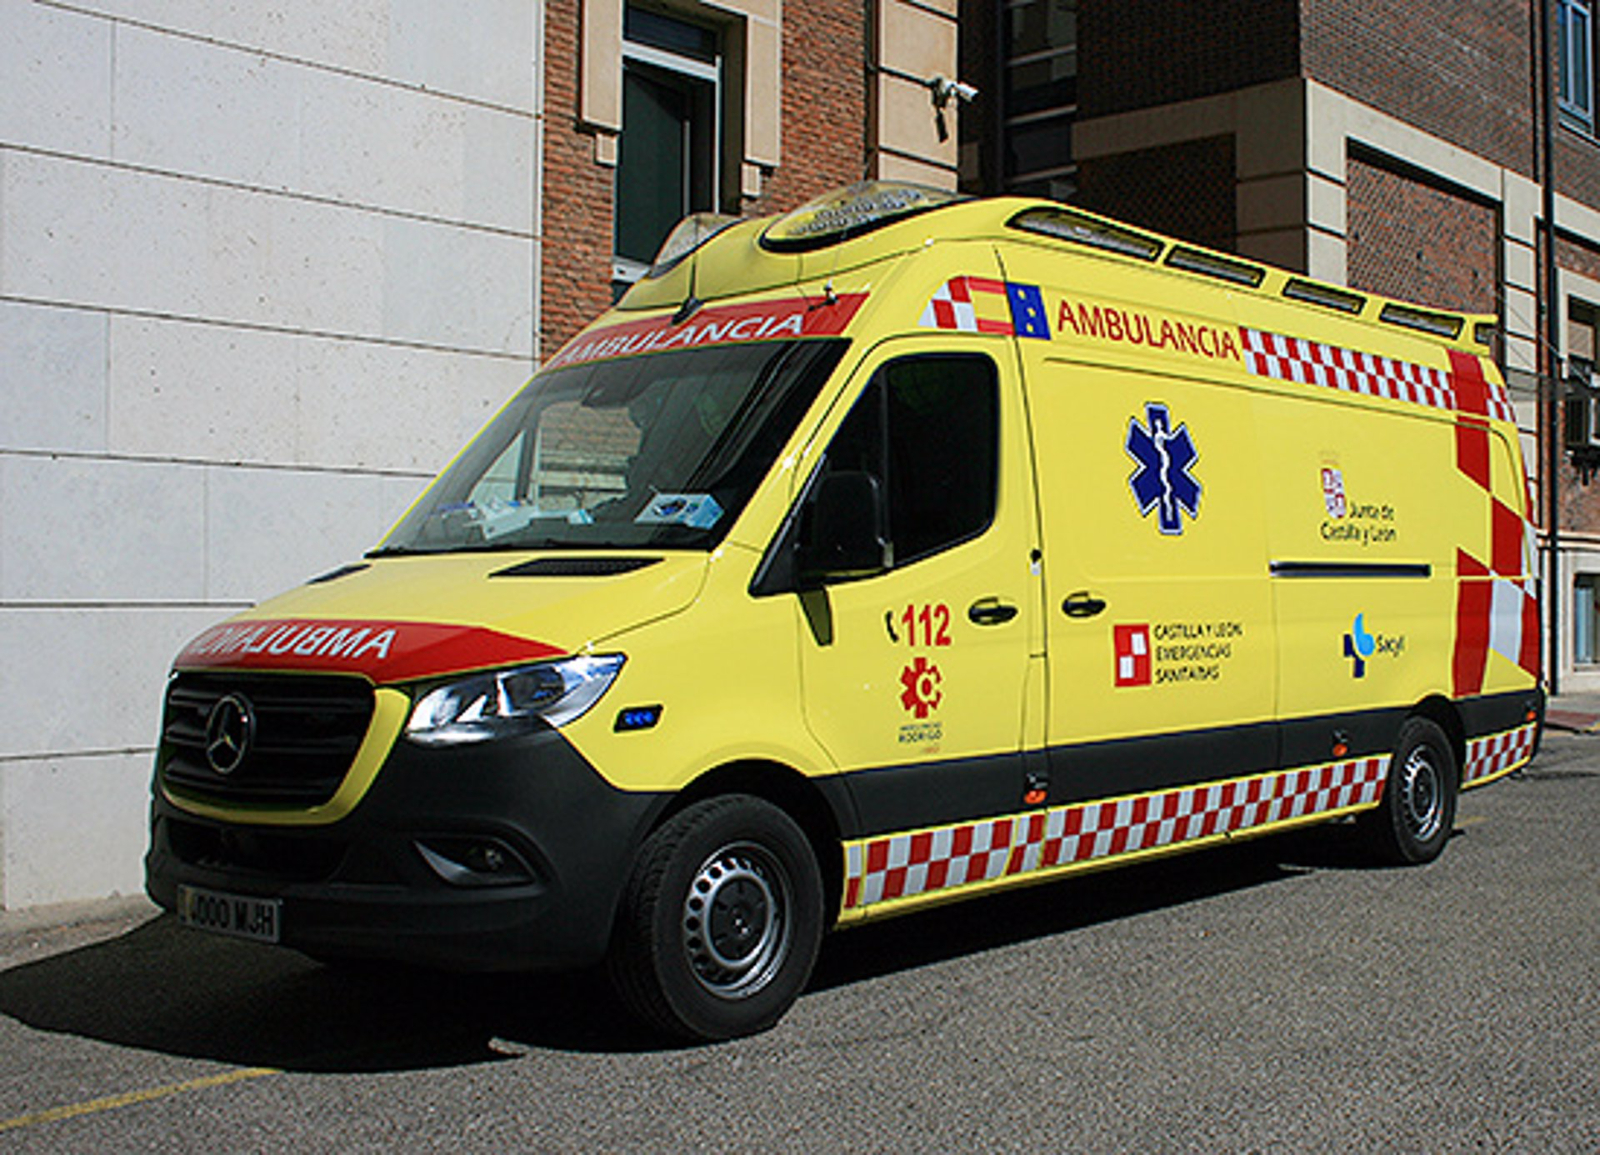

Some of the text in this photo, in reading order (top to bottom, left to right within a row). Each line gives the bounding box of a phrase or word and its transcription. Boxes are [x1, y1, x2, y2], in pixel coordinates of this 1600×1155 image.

[550, 313, 804, 367] AMBULANCIA
[1057, 299, 1241, 361] AMBULANCIA
[902, 603, 952, 647] 112
[1154, 623, 1204, 641] CASTILLA
[1155, 642, 1232, 662] EMERGENCIAS
